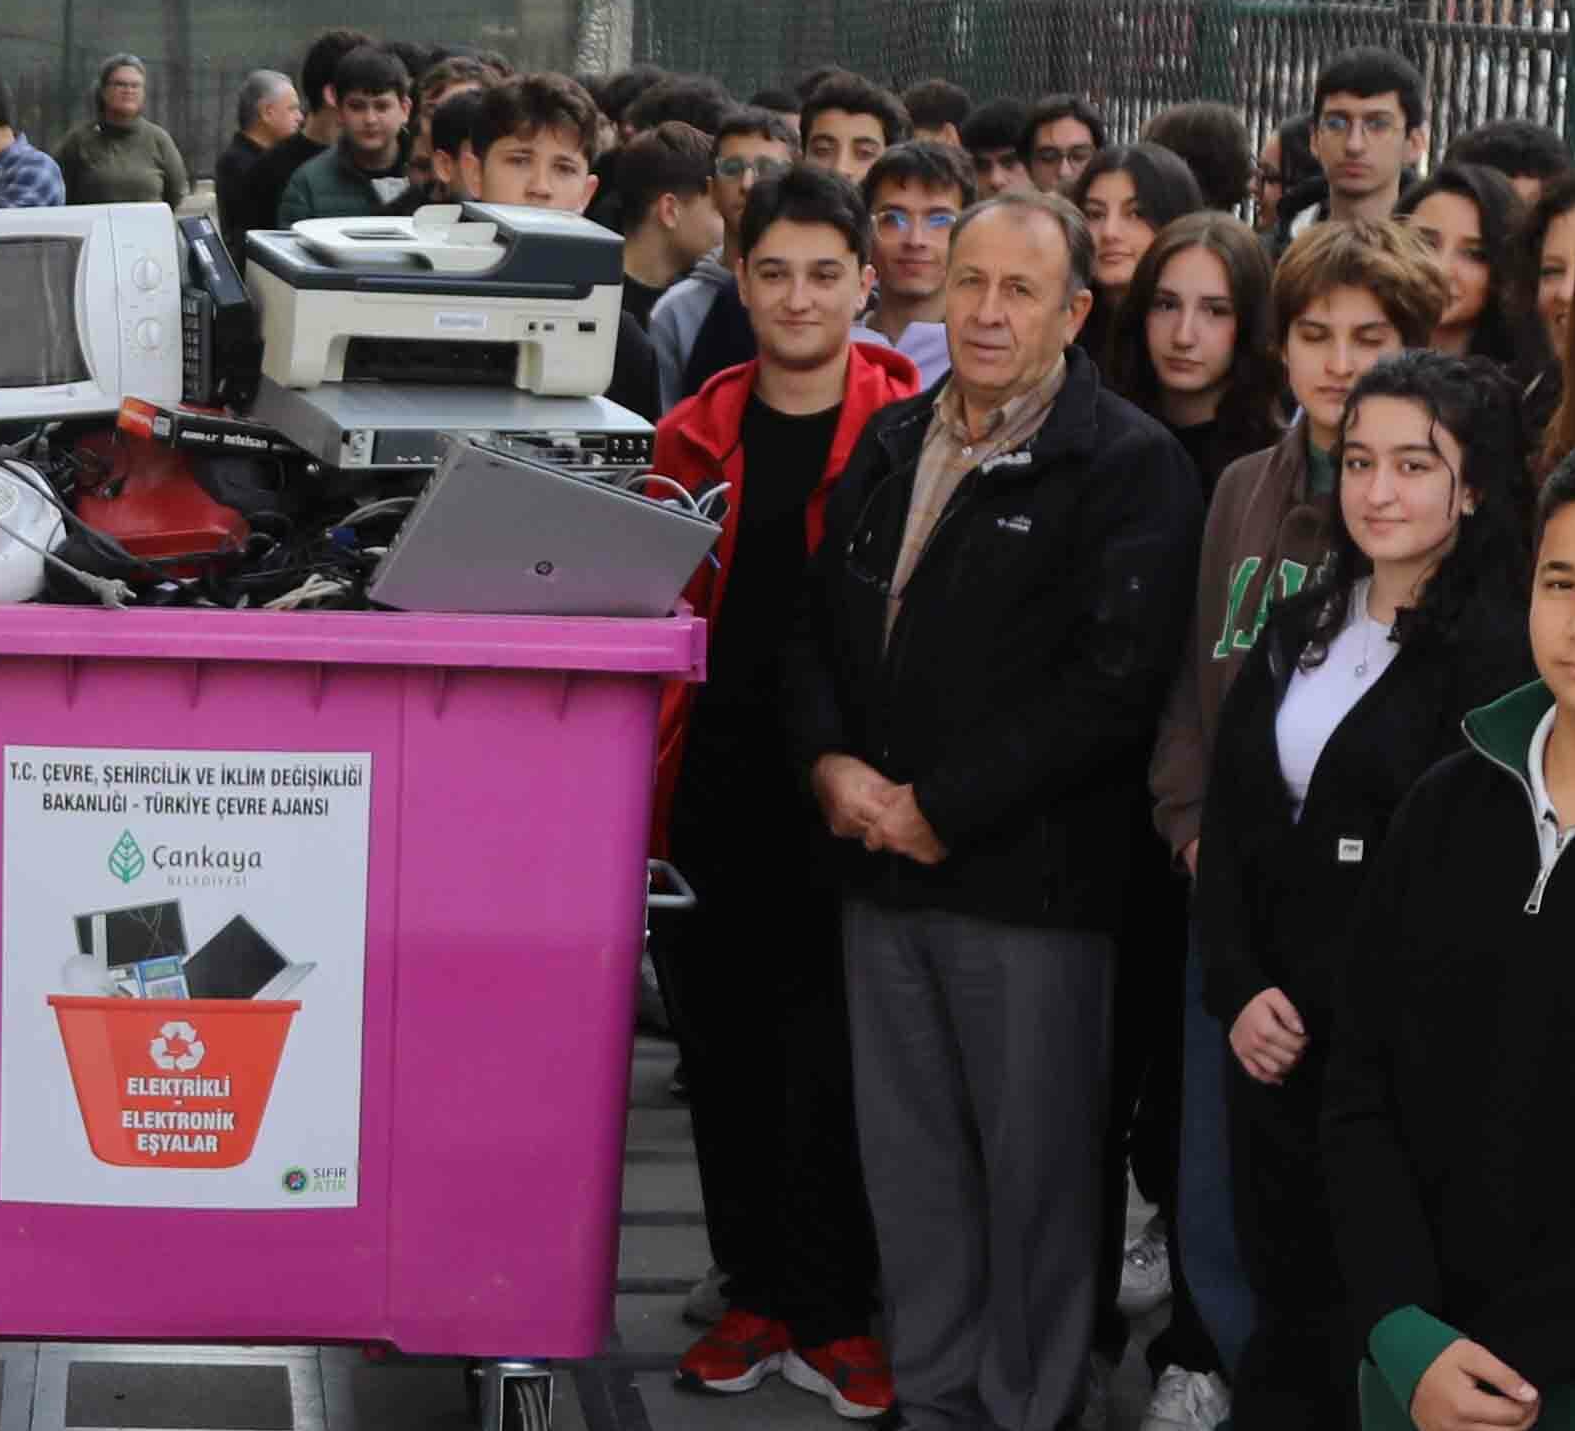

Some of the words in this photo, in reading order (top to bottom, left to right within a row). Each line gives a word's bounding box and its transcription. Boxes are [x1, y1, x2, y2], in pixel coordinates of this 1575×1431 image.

[10, 761, 37, 782] T.C.
[42, 763, 98, 787] ÇEVRE,
[102, 761, 191, 789] ŞEHİRCİLİK
[196, 766, 215, 785] VE
[221, 763, 265, 786] İKLİM
[271, 762, 362, 791] DEĞİŞİKLİĞİ
[42, 791, 127, 813] BAKANLIĞI
[145, 792, 210, 814] TÜRKİYE
[216, 797, 267, 820] ÇEVRE
[272, 797, 329, 816] AJANSI
[152, 844, 262, 873] Çankaya
[126, 1074, 231, 1097] ELEKTRİKLİ
[121, 1108, 235, 1130] ELEKTRONİK
[137, 1133, 218, 1156] EŞYALAR
